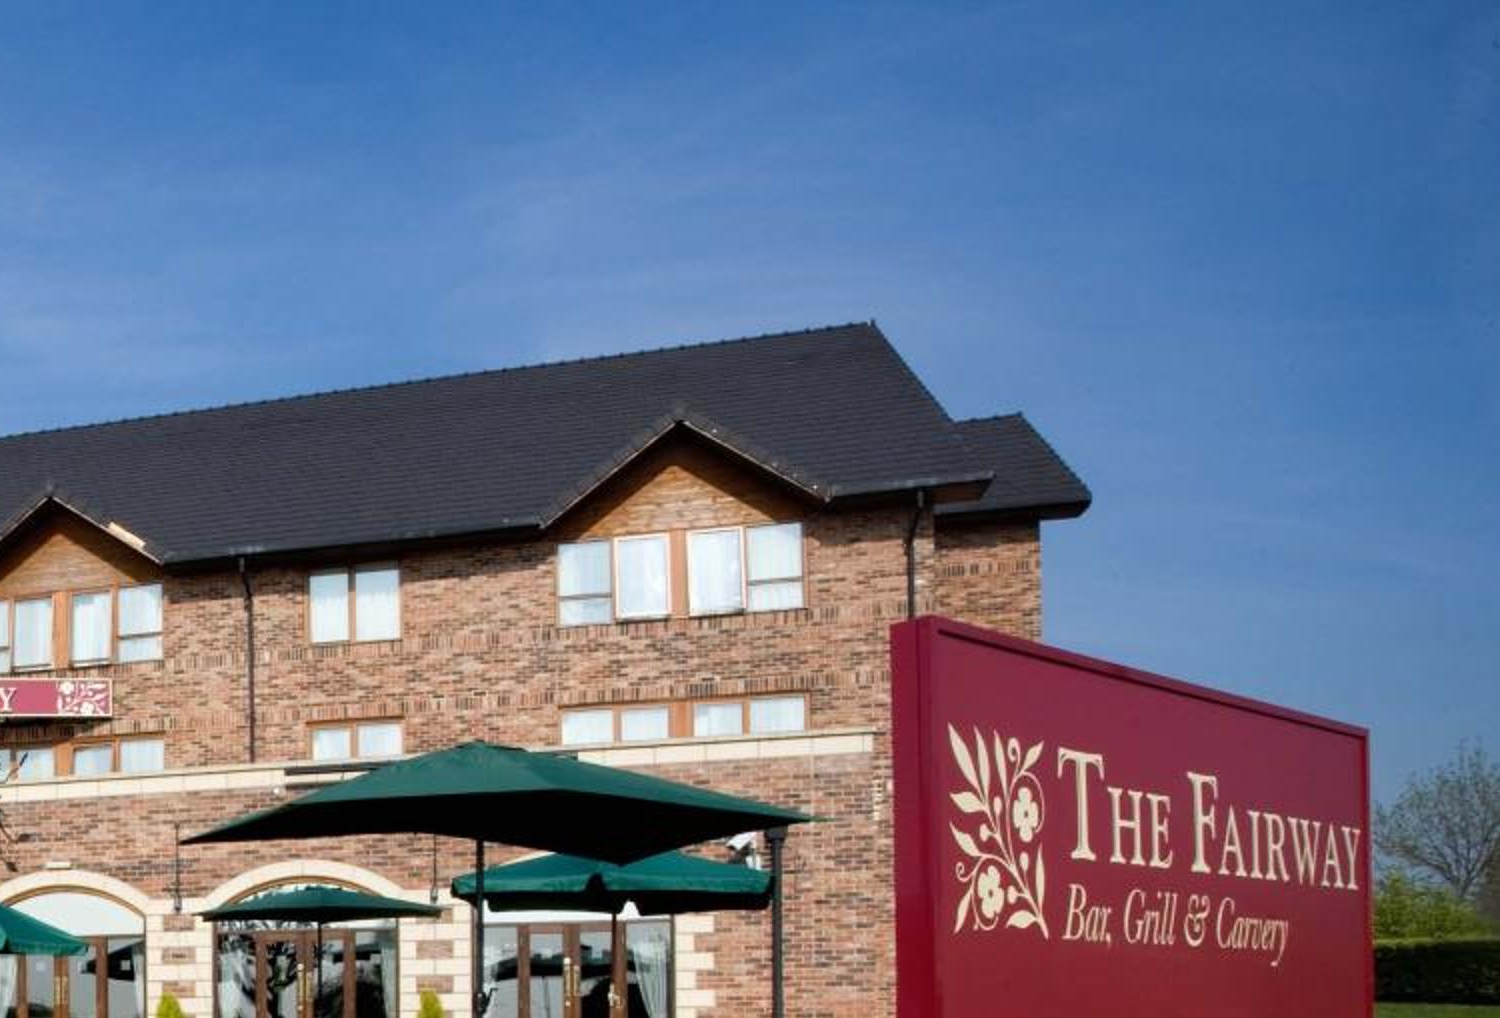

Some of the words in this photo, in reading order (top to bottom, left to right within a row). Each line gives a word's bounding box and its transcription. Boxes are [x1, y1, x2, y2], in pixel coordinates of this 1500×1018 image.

[1057, 747, 1173, 869] THE
[1187, 771, 1361, 890] FAIRWAY
[1062, 883, 1112, 948] Bar,
[1123, 889, 1179, 945] Grill
[1183, 894, 1211, 947] &
[1216, 897, 1289, 967] Carvery
